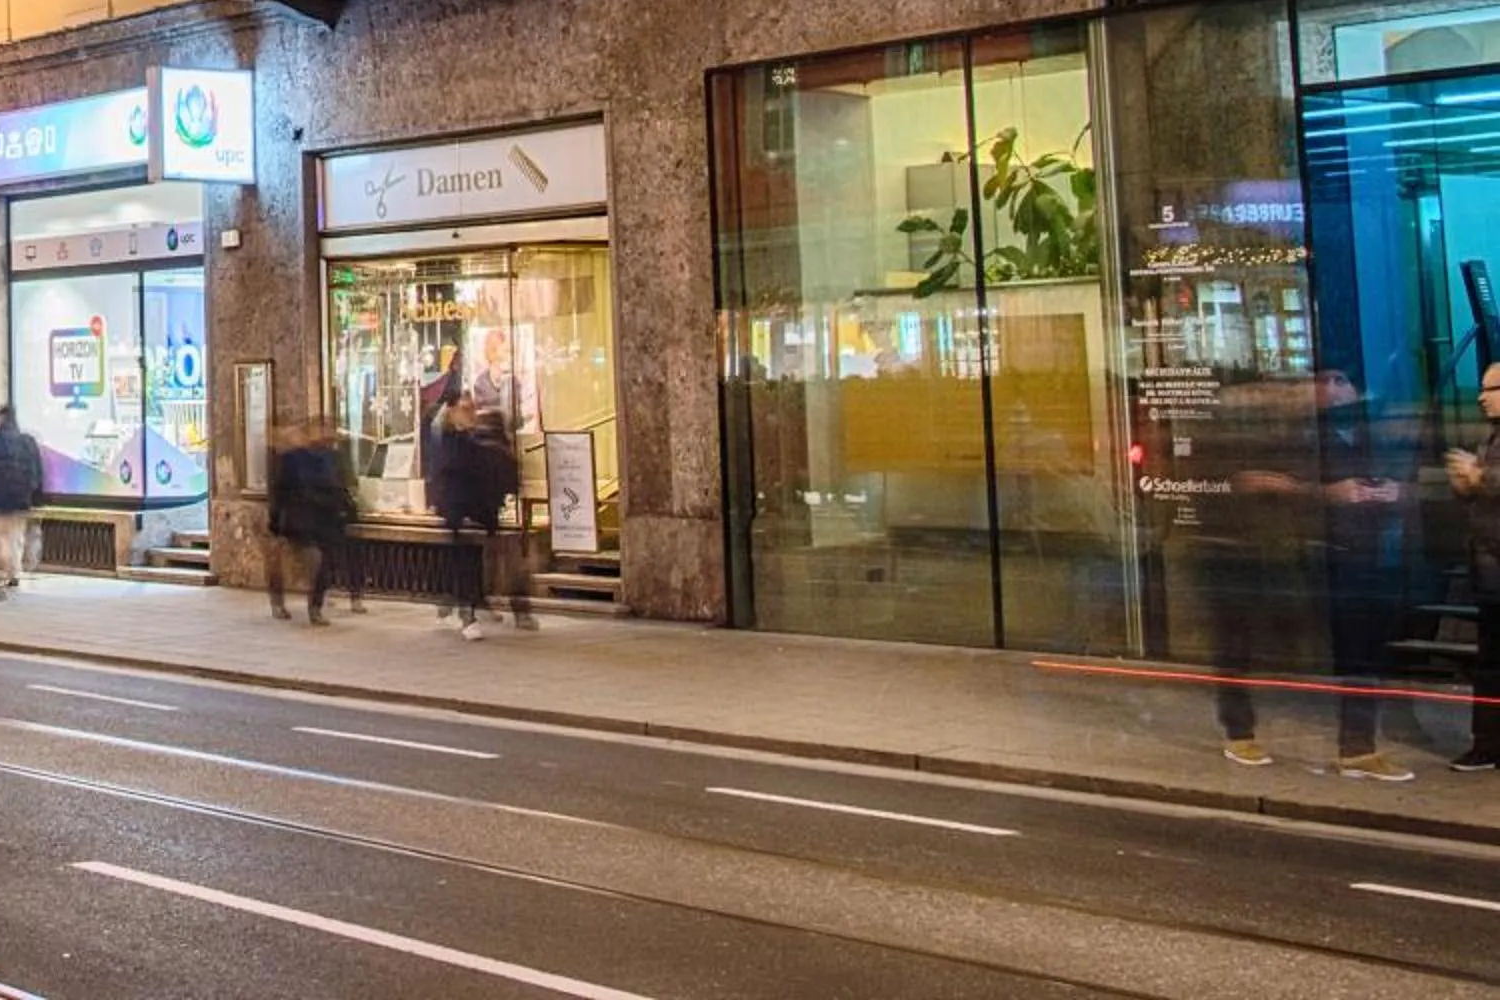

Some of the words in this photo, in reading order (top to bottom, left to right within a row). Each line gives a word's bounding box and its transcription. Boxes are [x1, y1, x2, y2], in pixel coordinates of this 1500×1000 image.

[215, 149, 245, 167] upc
[416, 167, 502, 197] Damen
[1161, 204, 1175, 223] 5
[54, 340, 100, 358] HORIZON
[68, 363, 85, 380] TV
[1153, 477, 1232, 493] Schoellerbank
